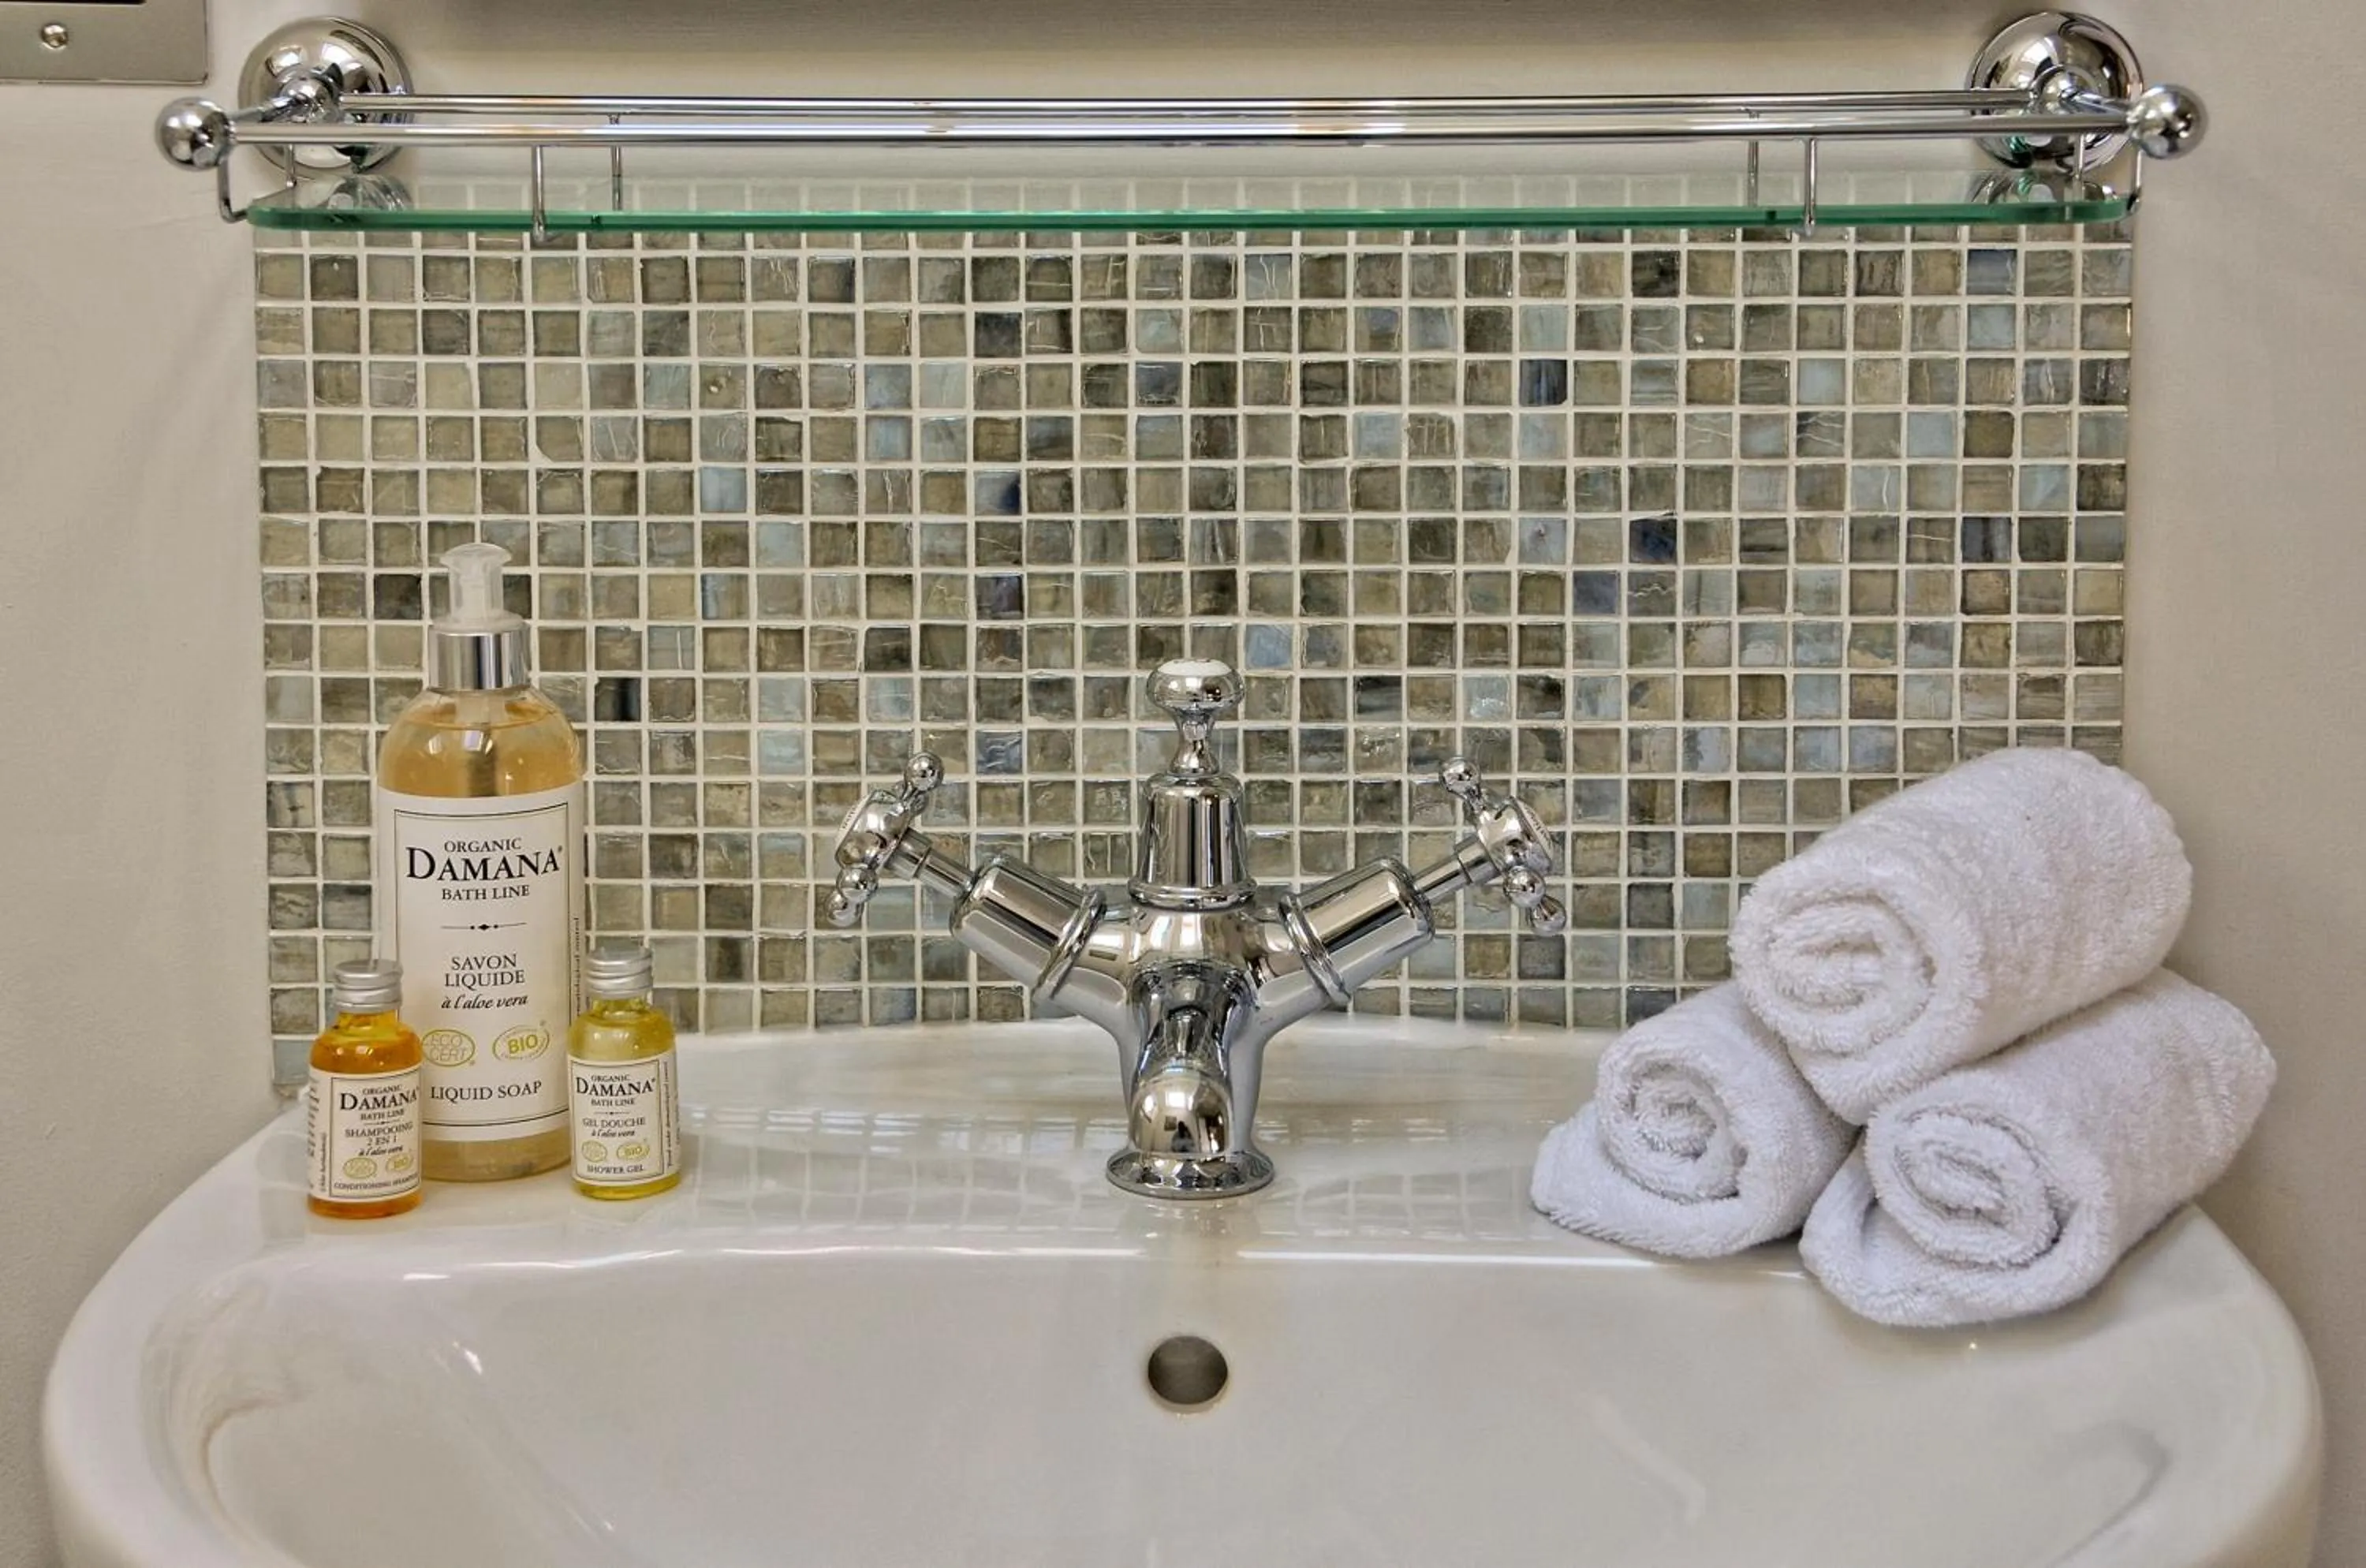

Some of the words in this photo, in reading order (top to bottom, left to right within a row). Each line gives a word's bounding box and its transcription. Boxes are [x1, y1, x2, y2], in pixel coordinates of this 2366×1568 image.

[444, 838, 522, 853] ORGANIC
[405, 846, 560, 881] DAMANA
[442, 887, 487, 901] BATH
[493, 884, 530, 899] LINE
[451, 953, 517, 971] SAVON
[444, 969, 526, 991] LIQUIDE
[441, 995, 451, 1009] à
[454, 993, 494, 1010] l'aloe
[496, 994, 528, 1009] vera
[507, 1034, 538, 1054] BIO
[592, 1073, 631, 1083] ORGANIC
[362, 1085, 403, 1096] ORGANIC
[431, 1085, 492, 1103] LIQUID
[498, 1081, 543, 1099] SOAP
[591, 1098, 613, 1107] BATH
[614, 1097, 635, 1107] LINE
[360, 1111, 385, 1121] BATH
[387, 1108, 405, 1118] LINE
[583, 1118, 598, 1128] GEL
[601, 1116, 646, 1128] DOUCHE
[345, 1121, 413, 1138] SHAMPOOING
[375, 1137, 390, 1146] EN
[587, 1164, 624, 1174] SHOWER
[627, 1163, 644, 1173] GEL
